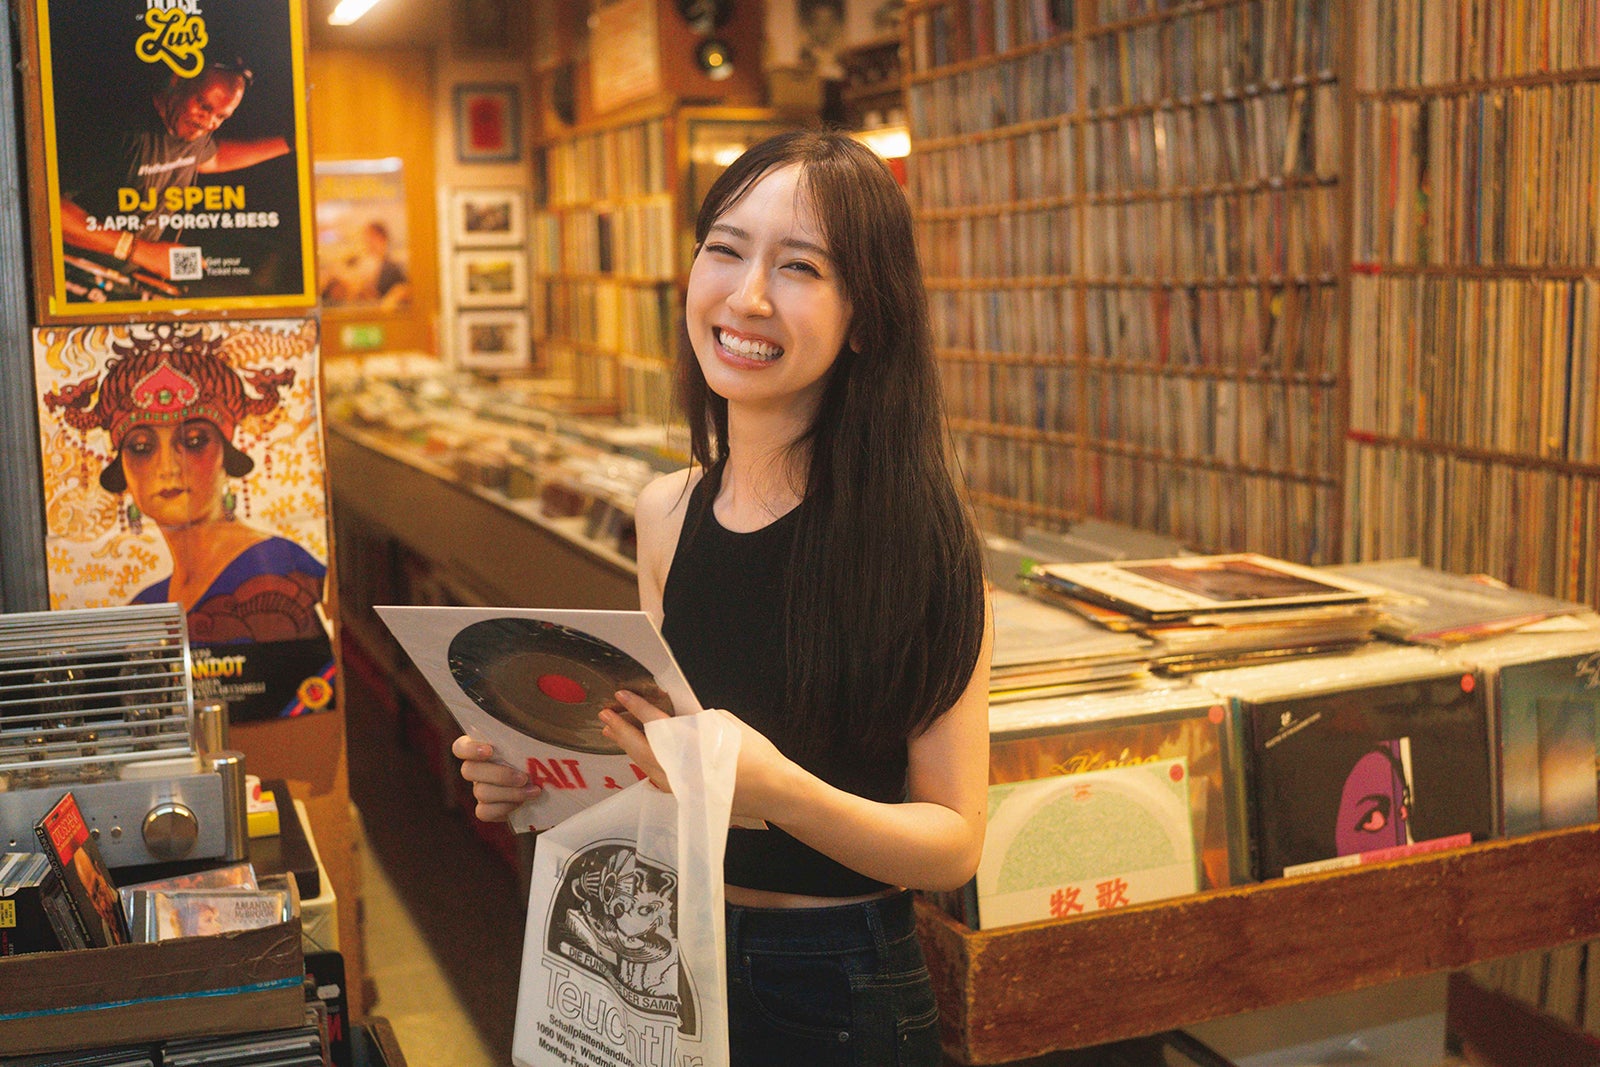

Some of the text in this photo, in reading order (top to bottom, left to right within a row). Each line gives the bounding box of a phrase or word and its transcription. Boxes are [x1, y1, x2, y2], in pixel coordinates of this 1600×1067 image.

[117, 185, 246, 212] DJ SPEN
[86, 215, 102, 232] 3.
[103, 215, 145, 231] APR.
[158, 213, 220, 230] PORGY
[235, 211, 280, 229] BESS
[527, 757, 588, 790] ALT
[1050, 877, 1129, 918] 牧歌
[568, 947, 583, 960] DIE
[622, 987, 640, 1005] DER
[536, 1021, 555, 1039] 1060
